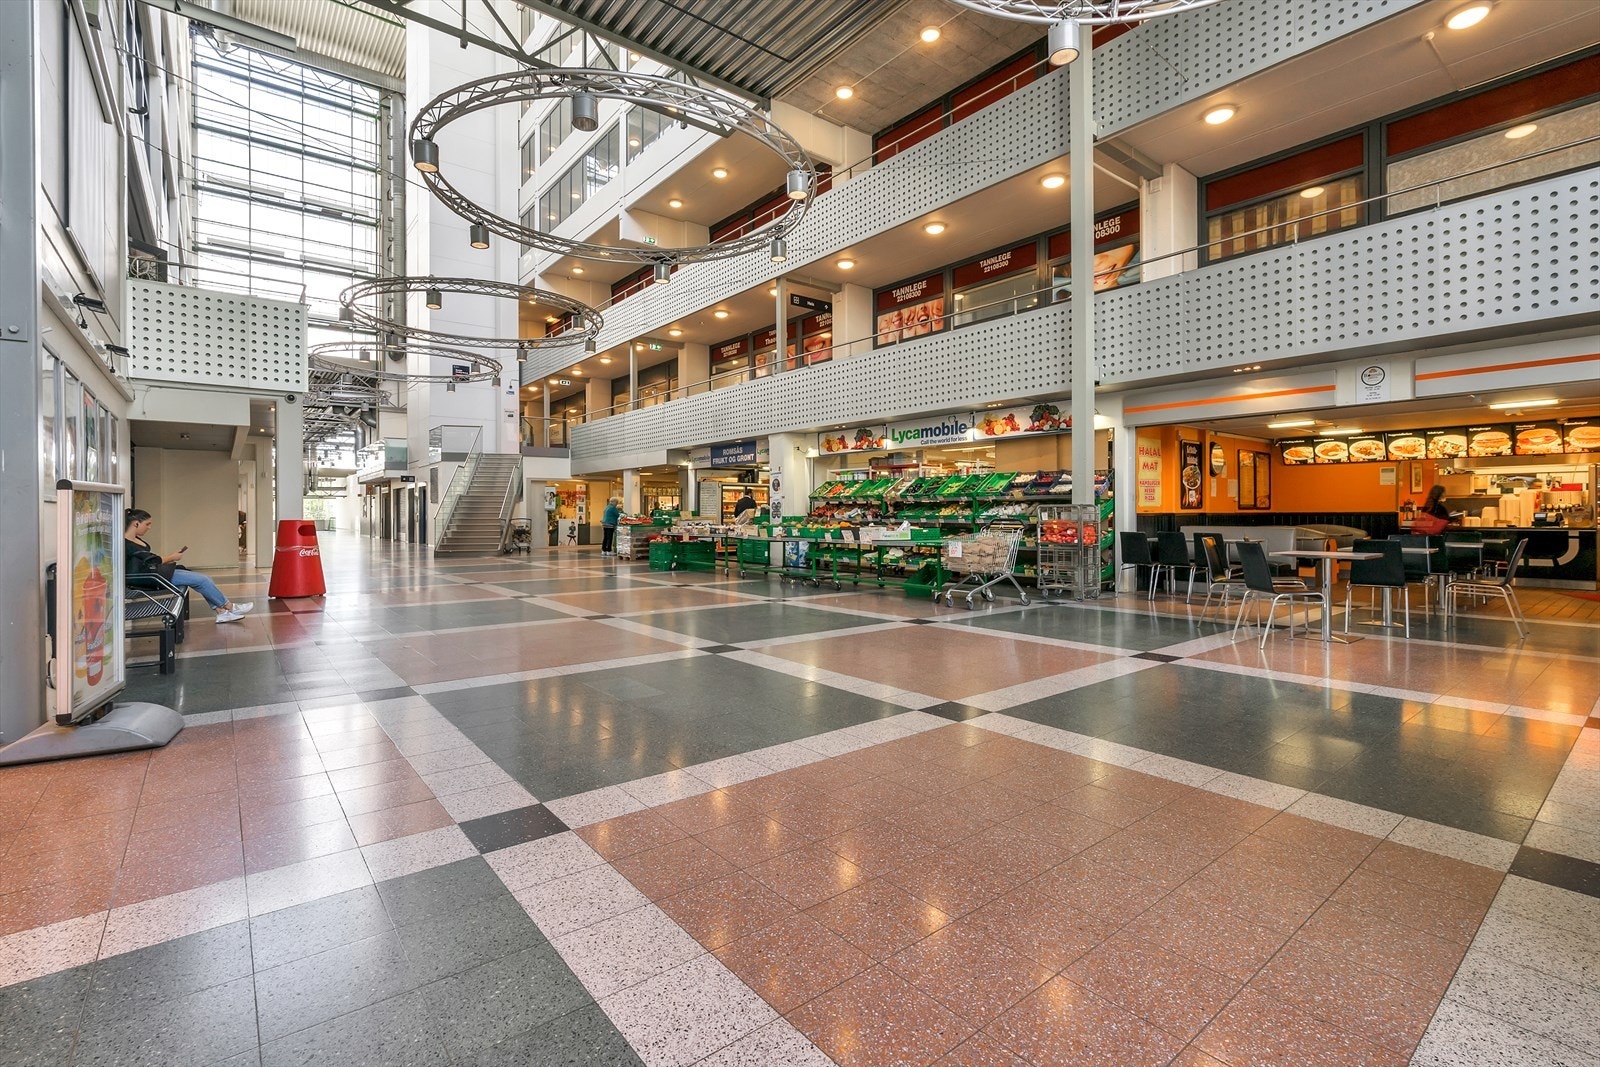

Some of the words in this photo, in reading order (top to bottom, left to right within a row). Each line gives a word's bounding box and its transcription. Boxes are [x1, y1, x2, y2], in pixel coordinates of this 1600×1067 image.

[1094, 216, 1121, 231] NLEGE
[1095, 225, 1121, 239] 08300
[979, 251, 1011, 268] TANNLEGE
[983, 260, 1009, 273] 22108300
[892, 280, 927, 297] TANNLEGE
[896, 290, 921, 302] 22108300
[891, 420, 968, 443] Lycamobile
[722, 445, 743, 455] ROMSÅS
[1138, 446, 1161, 456] HALAL
[1142, 462, 1158, 471] MAT
